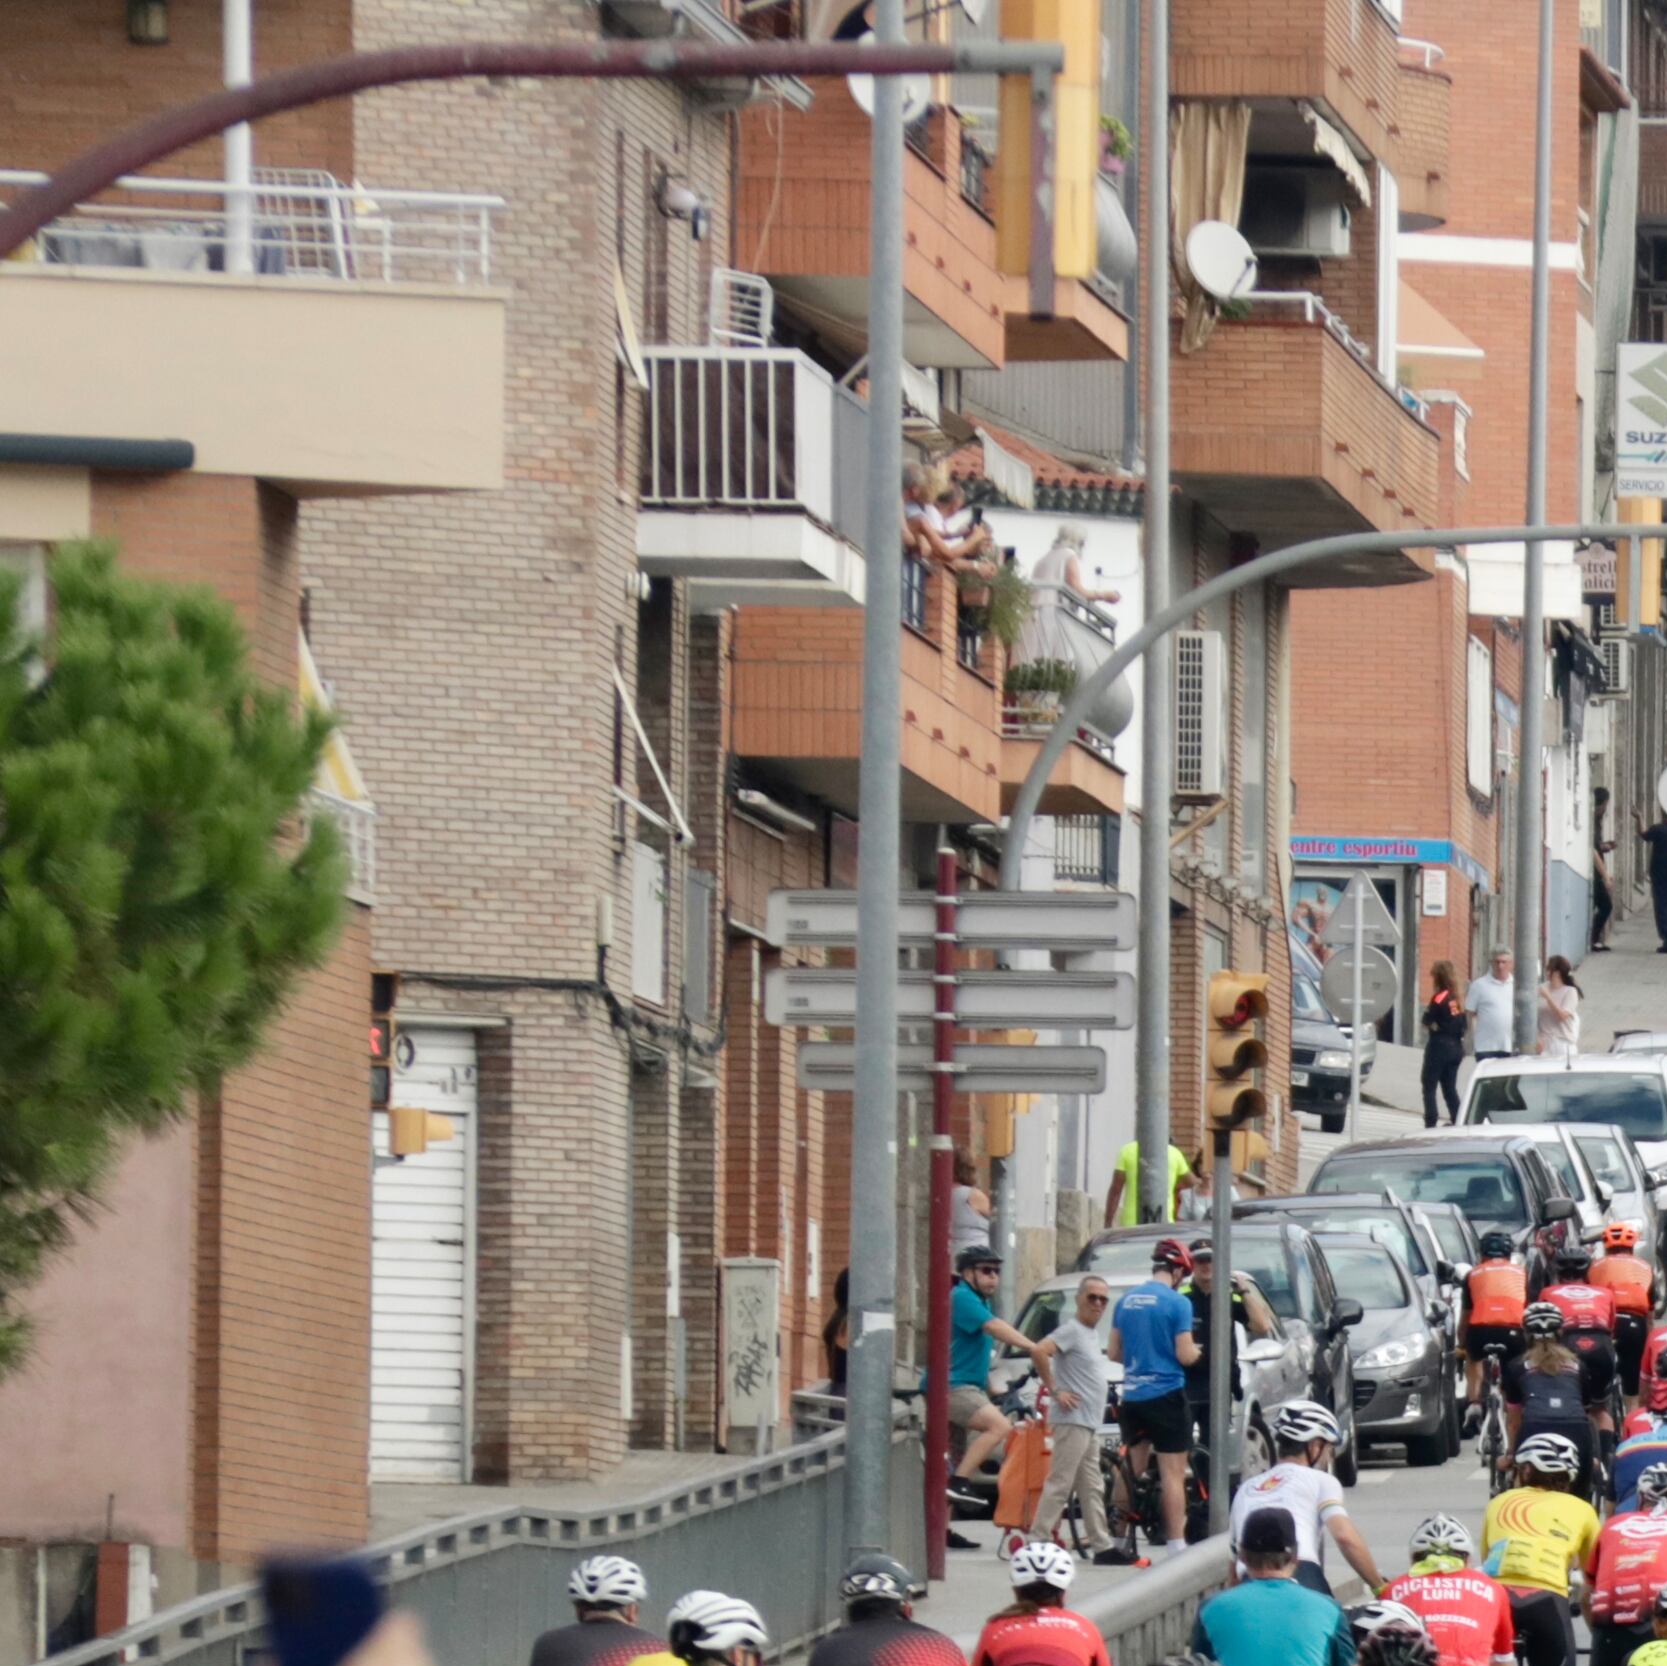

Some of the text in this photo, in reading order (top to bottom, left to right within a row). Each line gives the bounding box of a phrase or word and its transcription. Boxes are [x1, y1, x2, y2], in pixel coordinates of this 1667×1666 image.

[1619, 478, 1665, 492] SERVICIO
[1290, 840, 1417, 858] entre esportiu
[1391, 1576, 1494, 1603] CICLISTICA
[1422, 1588, 1461, 1601] LUNI
[1421, 1612, 1479, 1629] ROZZERIA
